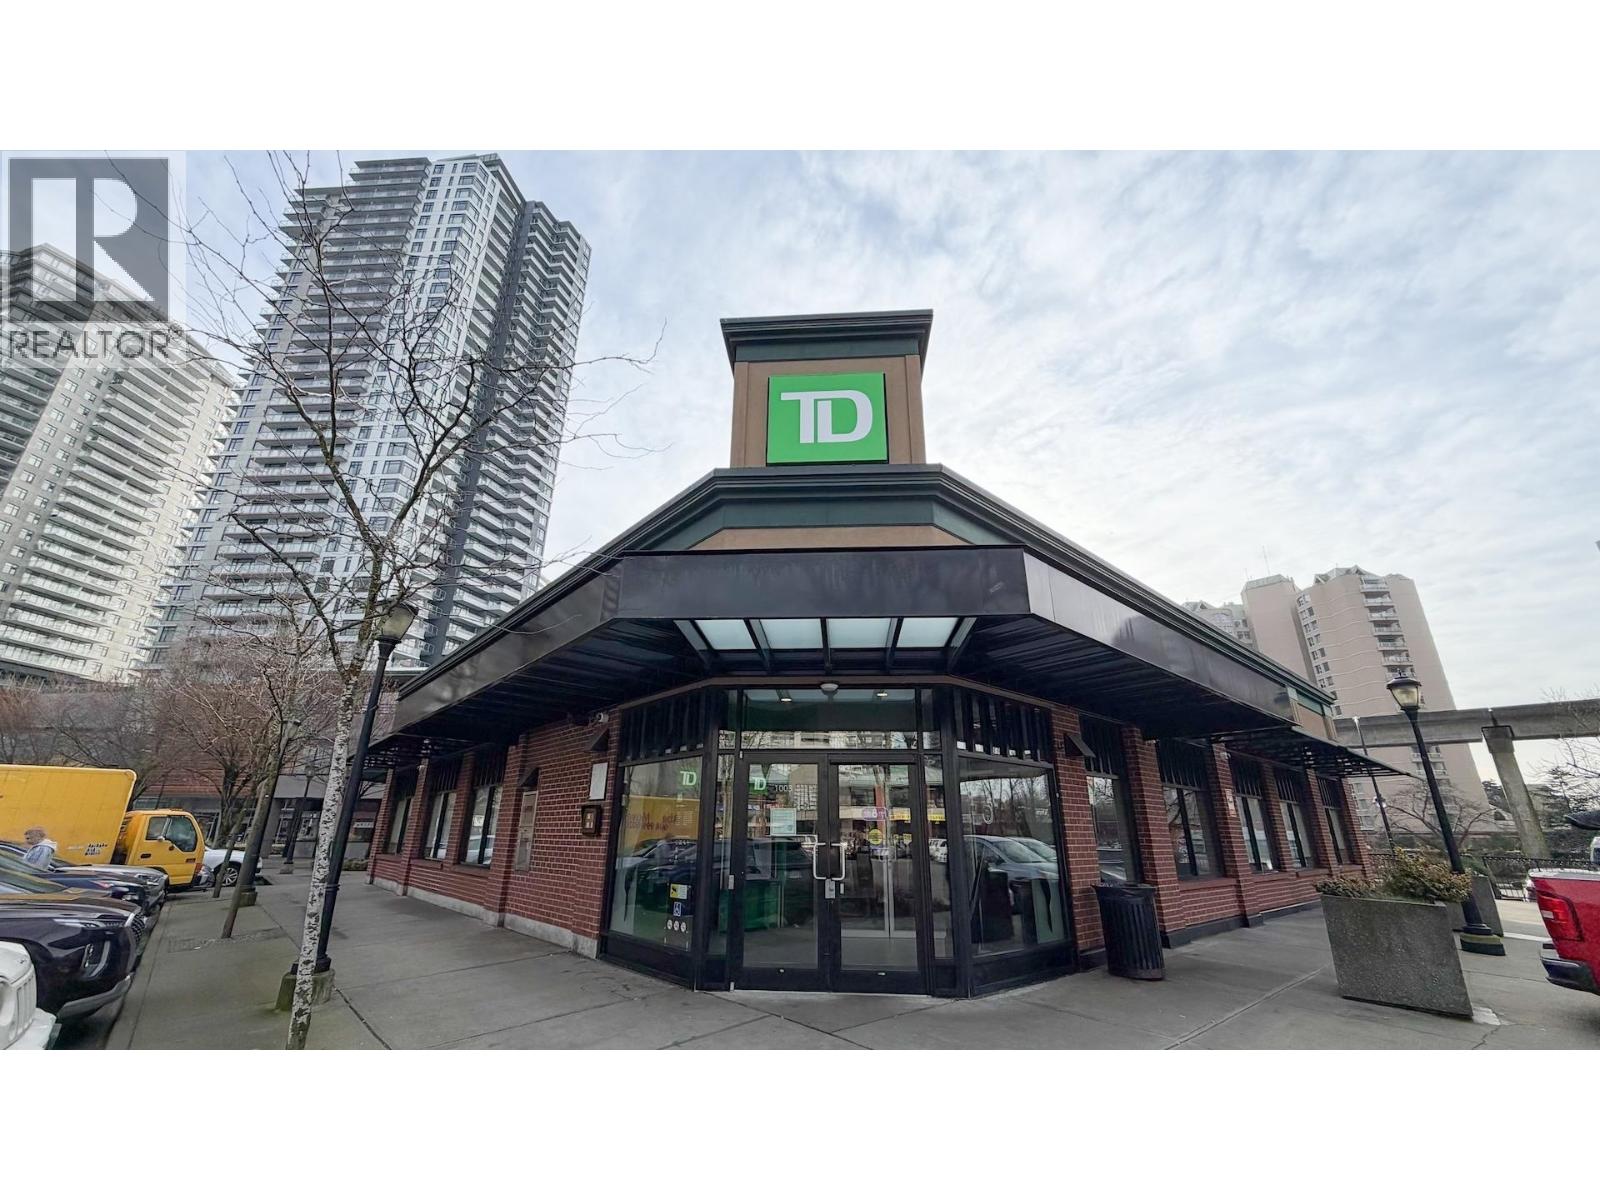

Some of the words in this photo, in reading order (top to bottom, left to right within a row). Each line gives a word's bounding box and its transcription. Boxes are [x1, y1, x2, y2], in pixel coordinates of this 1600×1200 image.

[780, 390, 873, 444] TD
[680, 771, 697, 786] TD
[751, 777, 767, 791] TD
